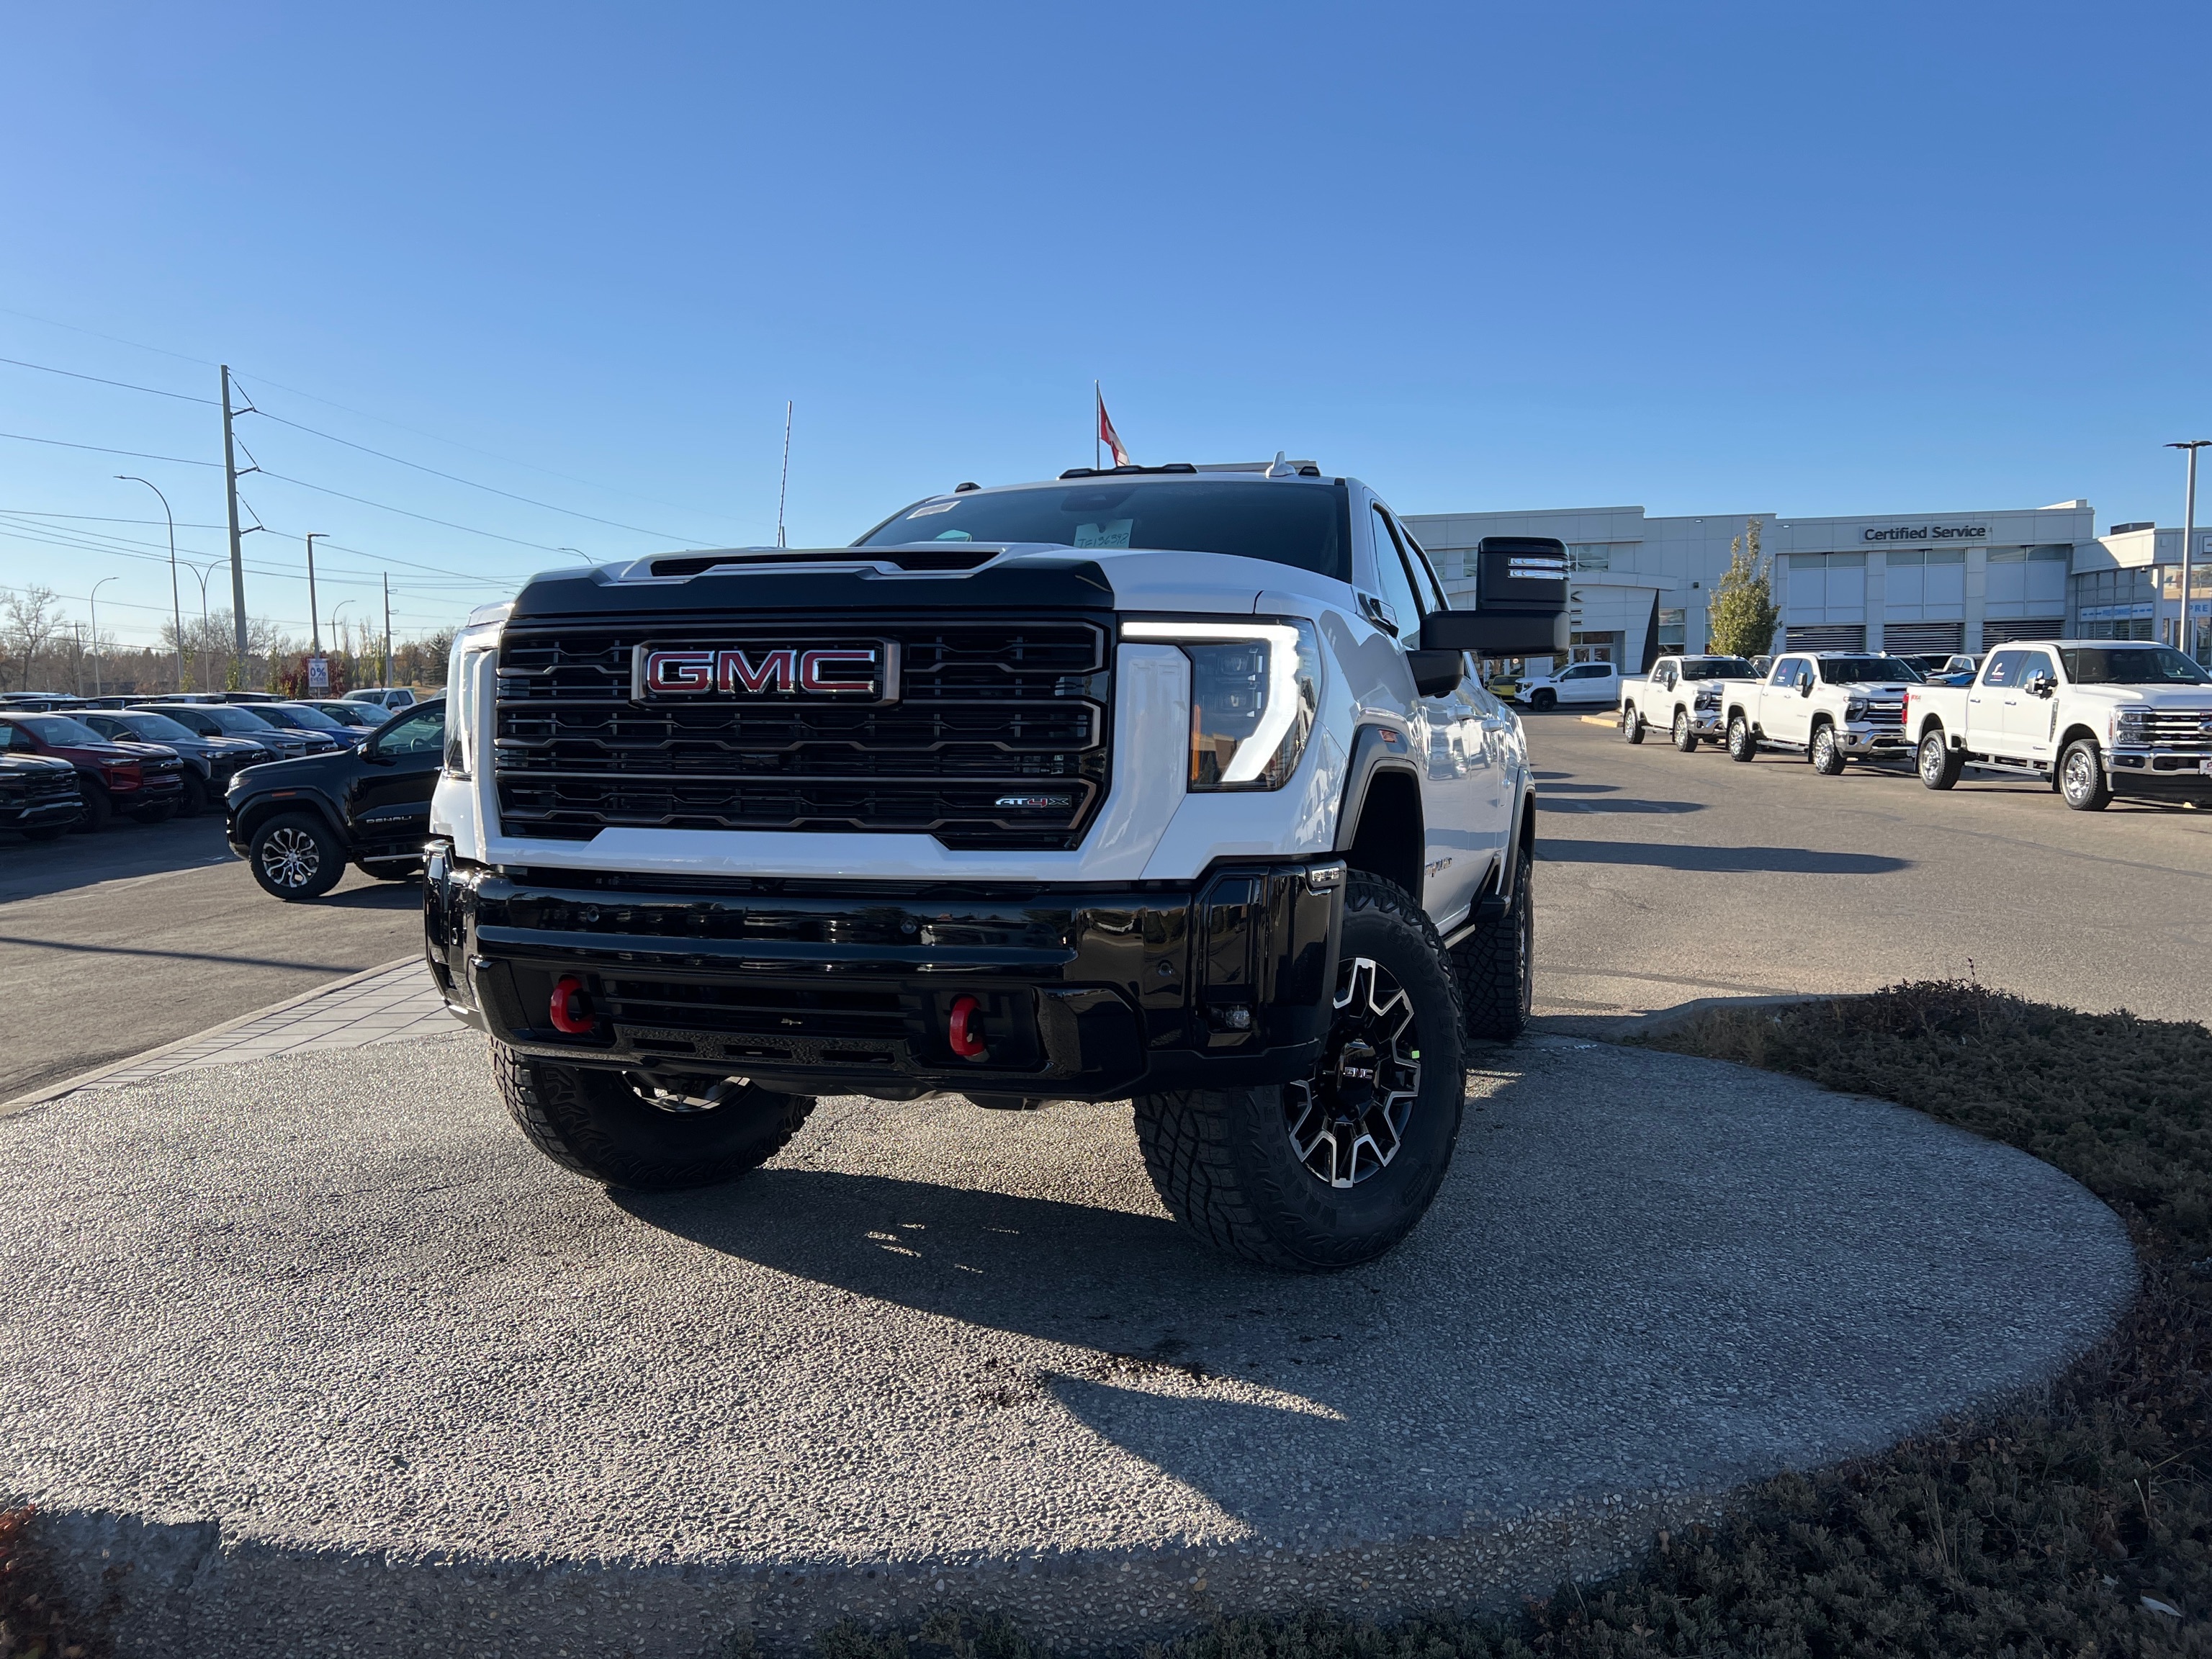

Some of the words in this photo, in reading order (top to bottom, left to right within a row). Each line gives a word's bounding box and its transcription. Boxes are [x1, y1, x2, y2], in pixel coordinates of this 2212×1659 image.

[1864, 526, 1927, 541] Certified
[1932, 525, 1986, 539] Service
[310, 667, 326, 677] 0%
[647, 649, 876, 694] GMC
[996, 798, 1069, 808] AT4X
[366, 815, 412, 824] DENALI
[1388, 924, 1457, 1076] GOODYEAR
[1344, 1066, 1373, 1079] GMC
